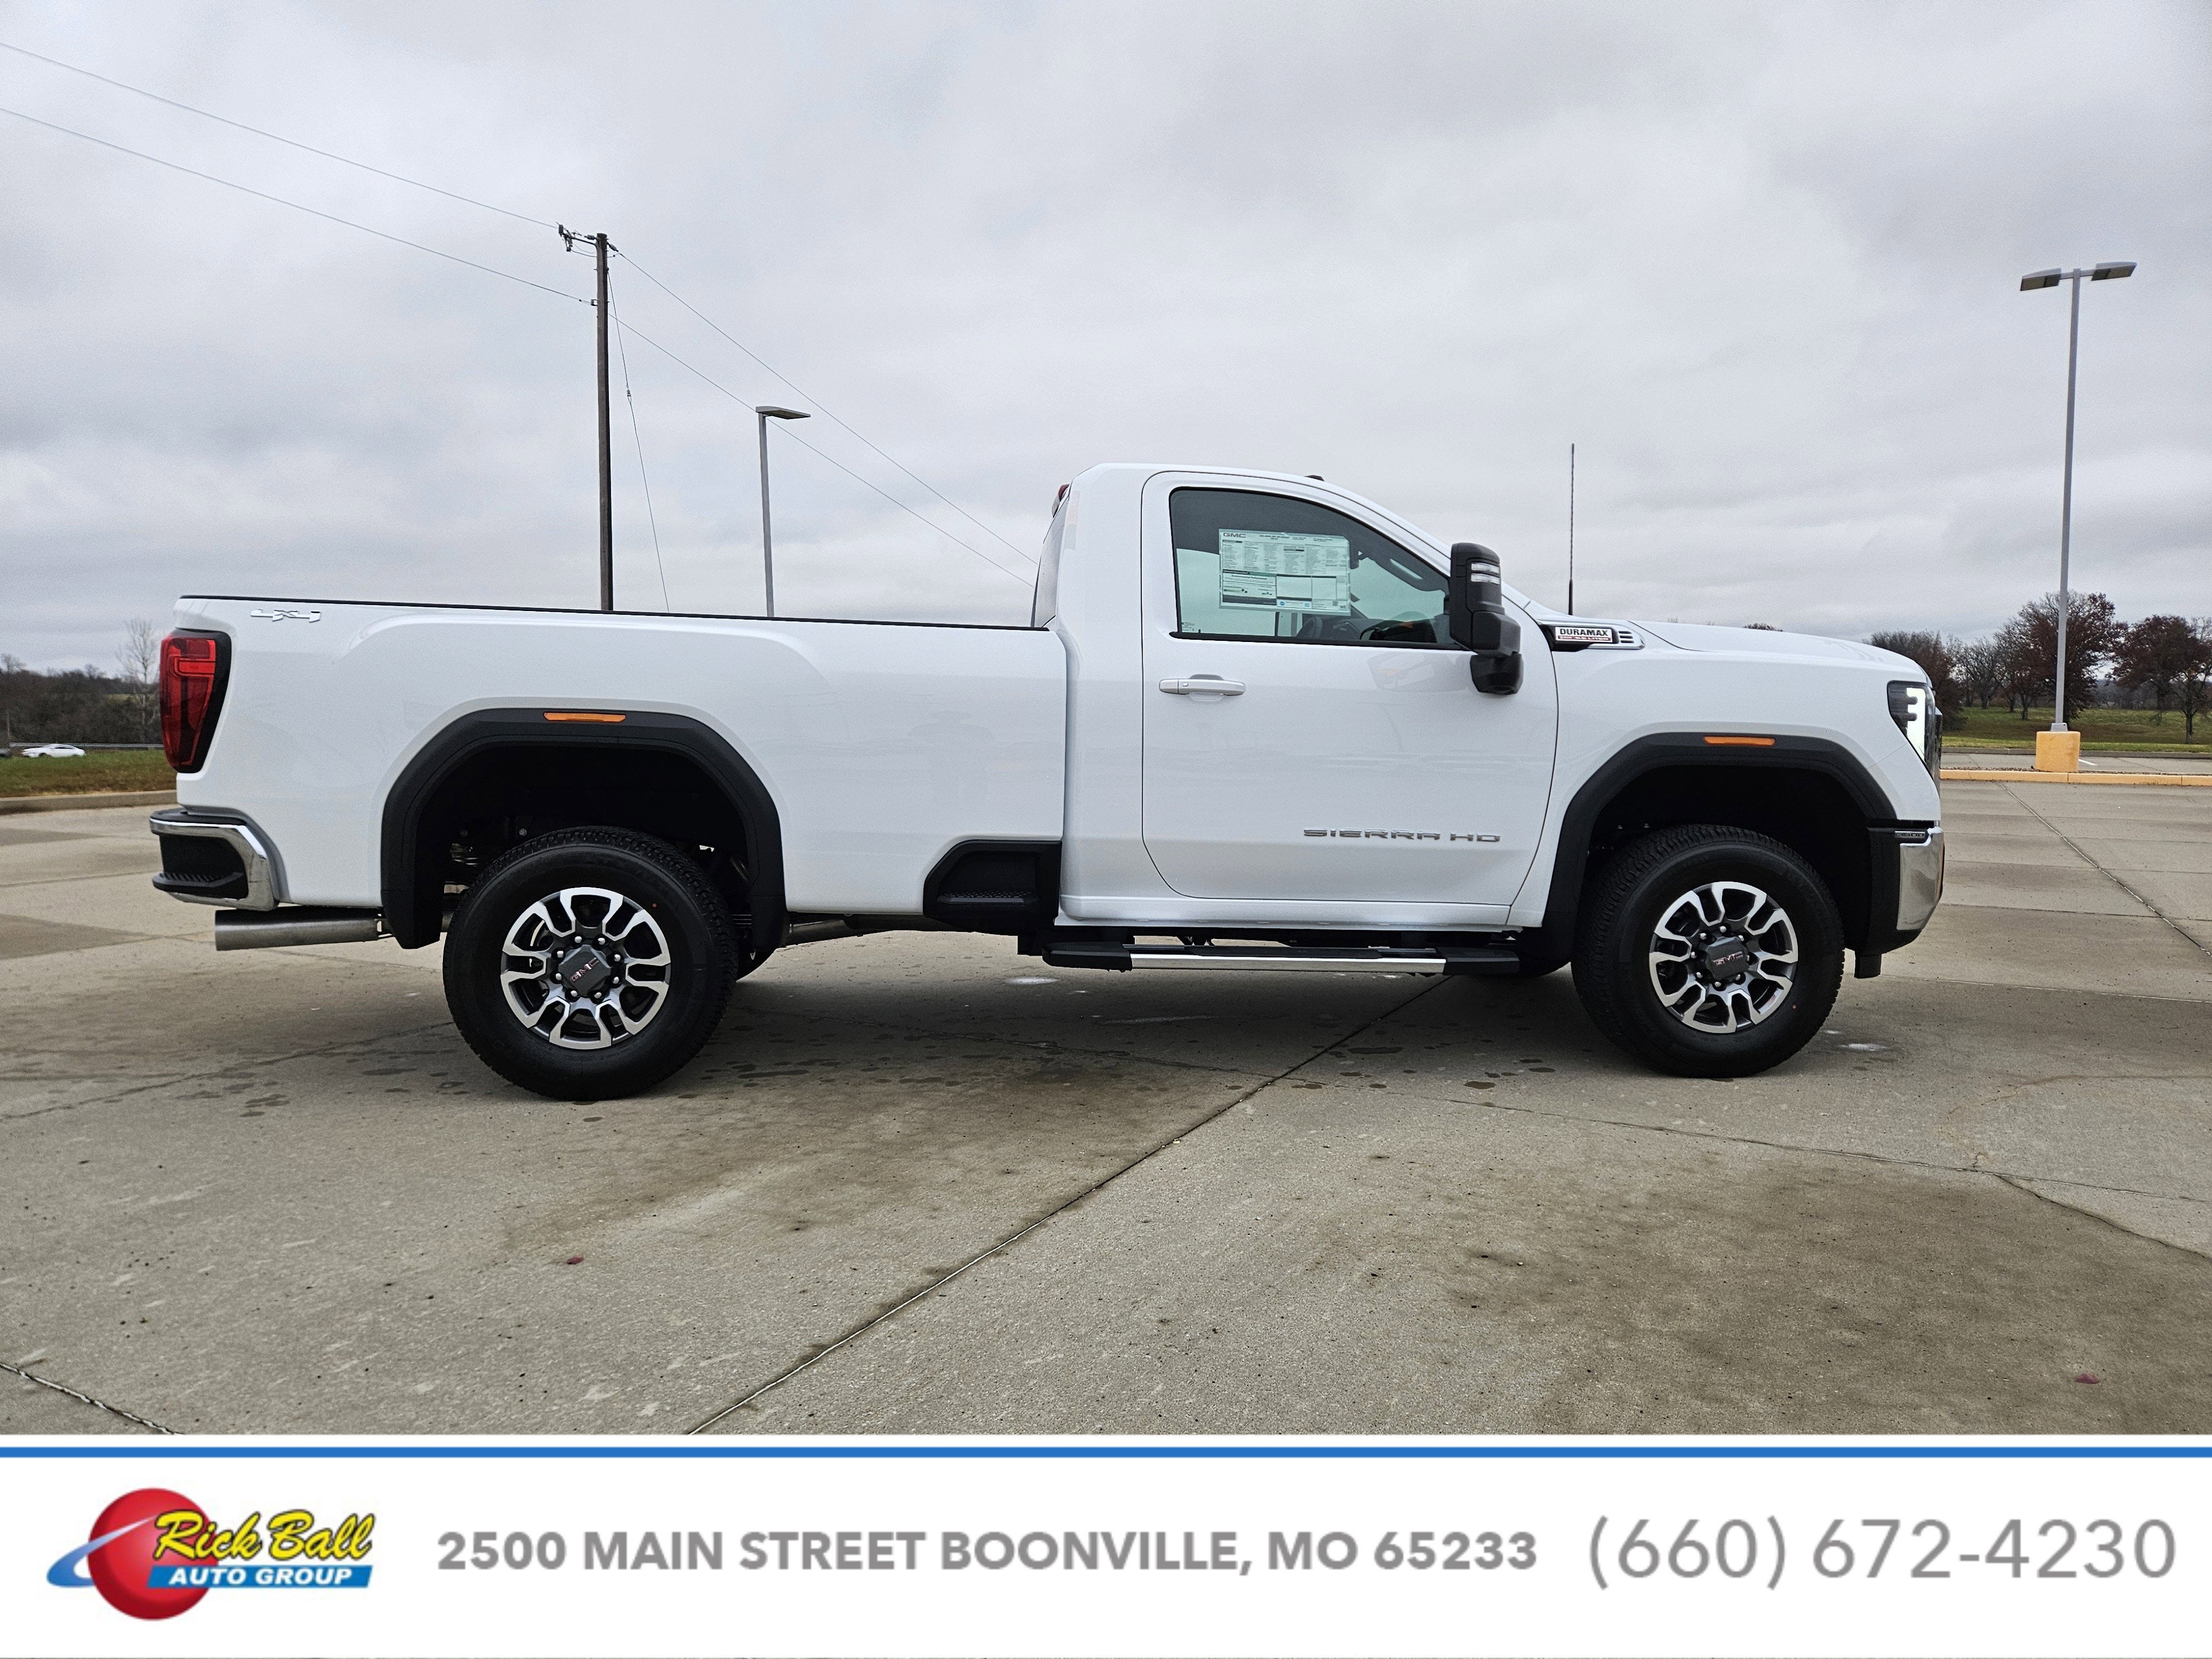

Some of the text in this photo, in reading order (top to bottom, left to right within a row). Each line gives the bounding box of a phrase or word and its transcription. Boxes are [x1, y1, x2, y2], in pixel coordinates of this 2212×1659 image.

[1560, 628, 1608, 637] DURAMAX
[1304, 827, 1500, 842] SIERRA HD
[1713, 951, 1743, 967] GMC
[569, 957, 599, 983] GMC
